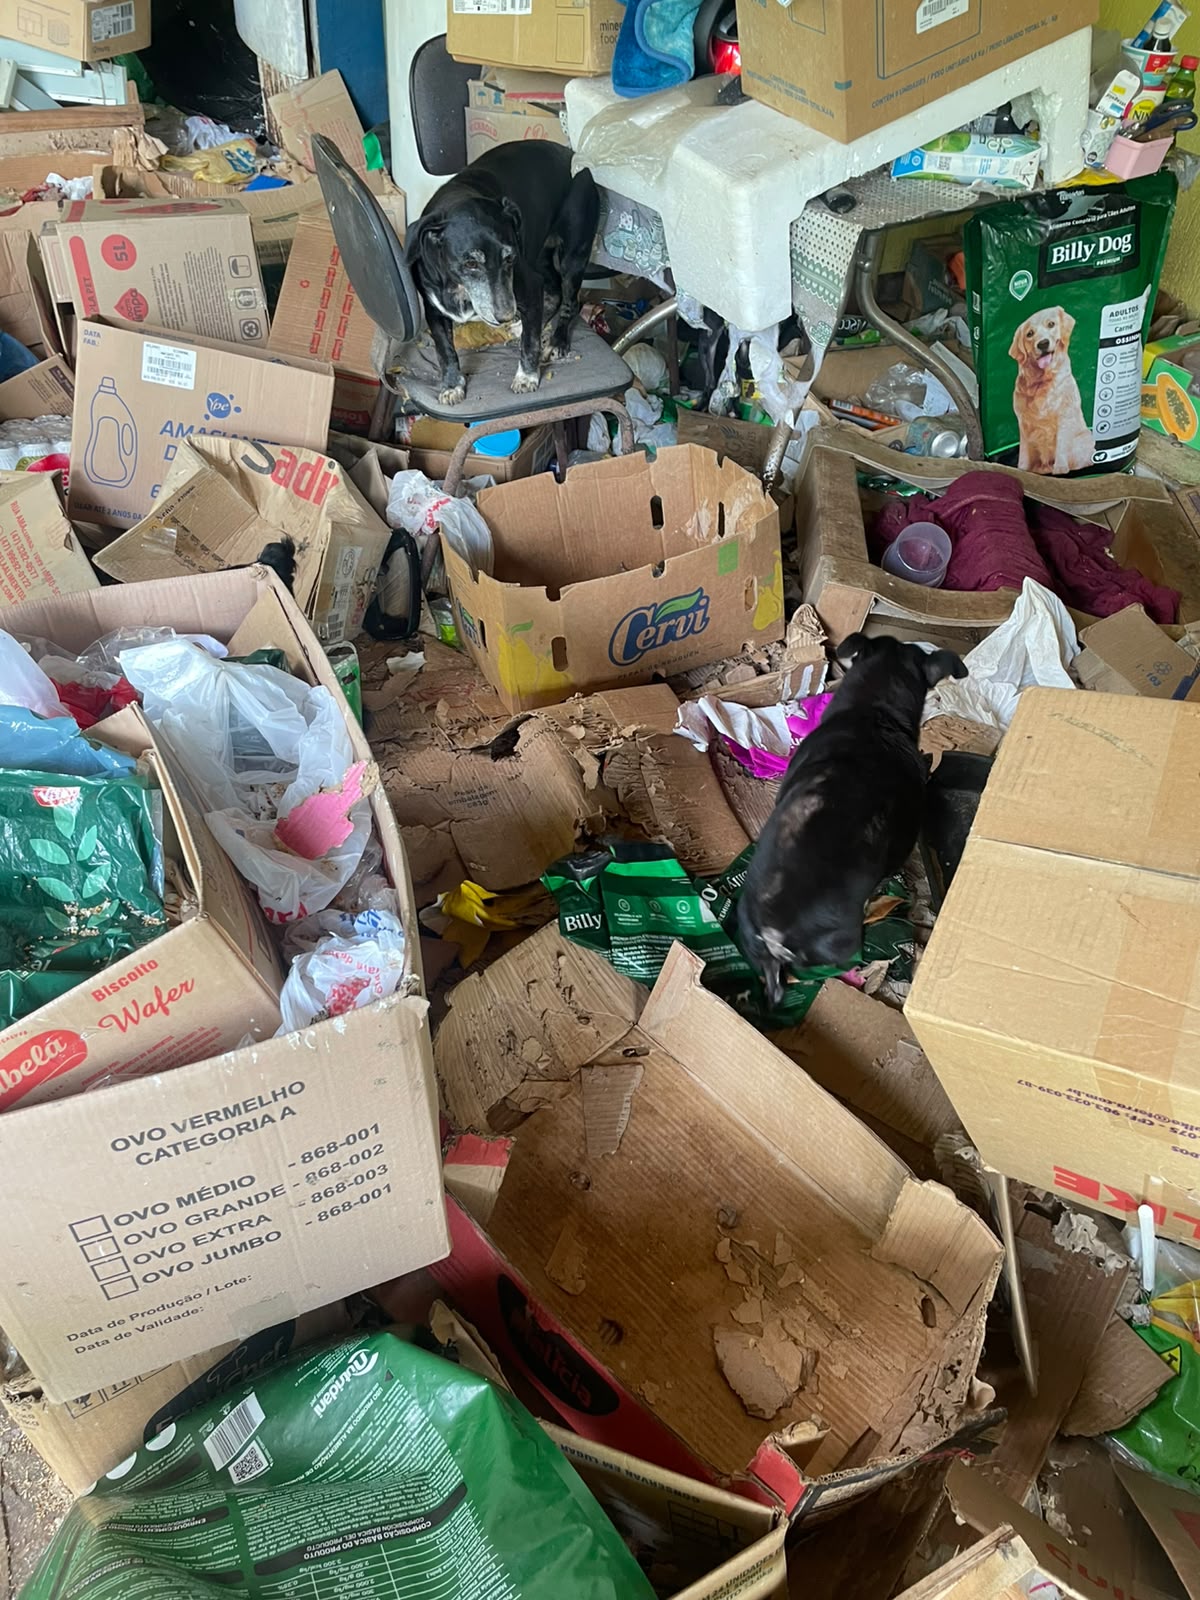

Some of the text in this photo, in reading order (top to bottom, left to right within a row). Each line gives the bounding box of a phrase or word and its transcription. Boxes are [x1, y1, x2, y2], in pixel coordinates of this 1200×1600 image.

[1051, 232, 1133, 265] Billy Dog
[1109, 305, 1139, 318] ADULTOS
[609, 587, 711, 666] Cervi
[564, 913, 603, 932] Billy
[97, 977, 195, 1033] Wafer
[110, 1080, 306, 1153] OVO VERMELHO
[135, 1105, 297, 1167] CATEGORIA A
[113, 1201, 170, 1228] OVO
[176, 1173, 256, 1209] MÉDIO
[300, 1122, 382, 1166] 868-001
[122, 1220, 179, 1247] OVO
[184, 1183, 286, 1228] GRANDE
[304, 1143, 386, 1186] 868-002
[133, 1240, 187, 1267] OVO
[192, 1212, 272, 1247] EXTRA
[310, 1163, 389, 1205] 868-003
[142, 1259, 195, 1285] OVO
[201, 1229, 283, 1267] JUMBO
[317, 1182, 393, 1224] 868-001
[66, 1325, 103, 1343] Data
[107, 1317, 126, 1330] de
[128, 1289, 204, 1324] Produção
[214, 1274, 253, 1293] Lote:
[74, 1305, 205, 1355] Data de Validade:
